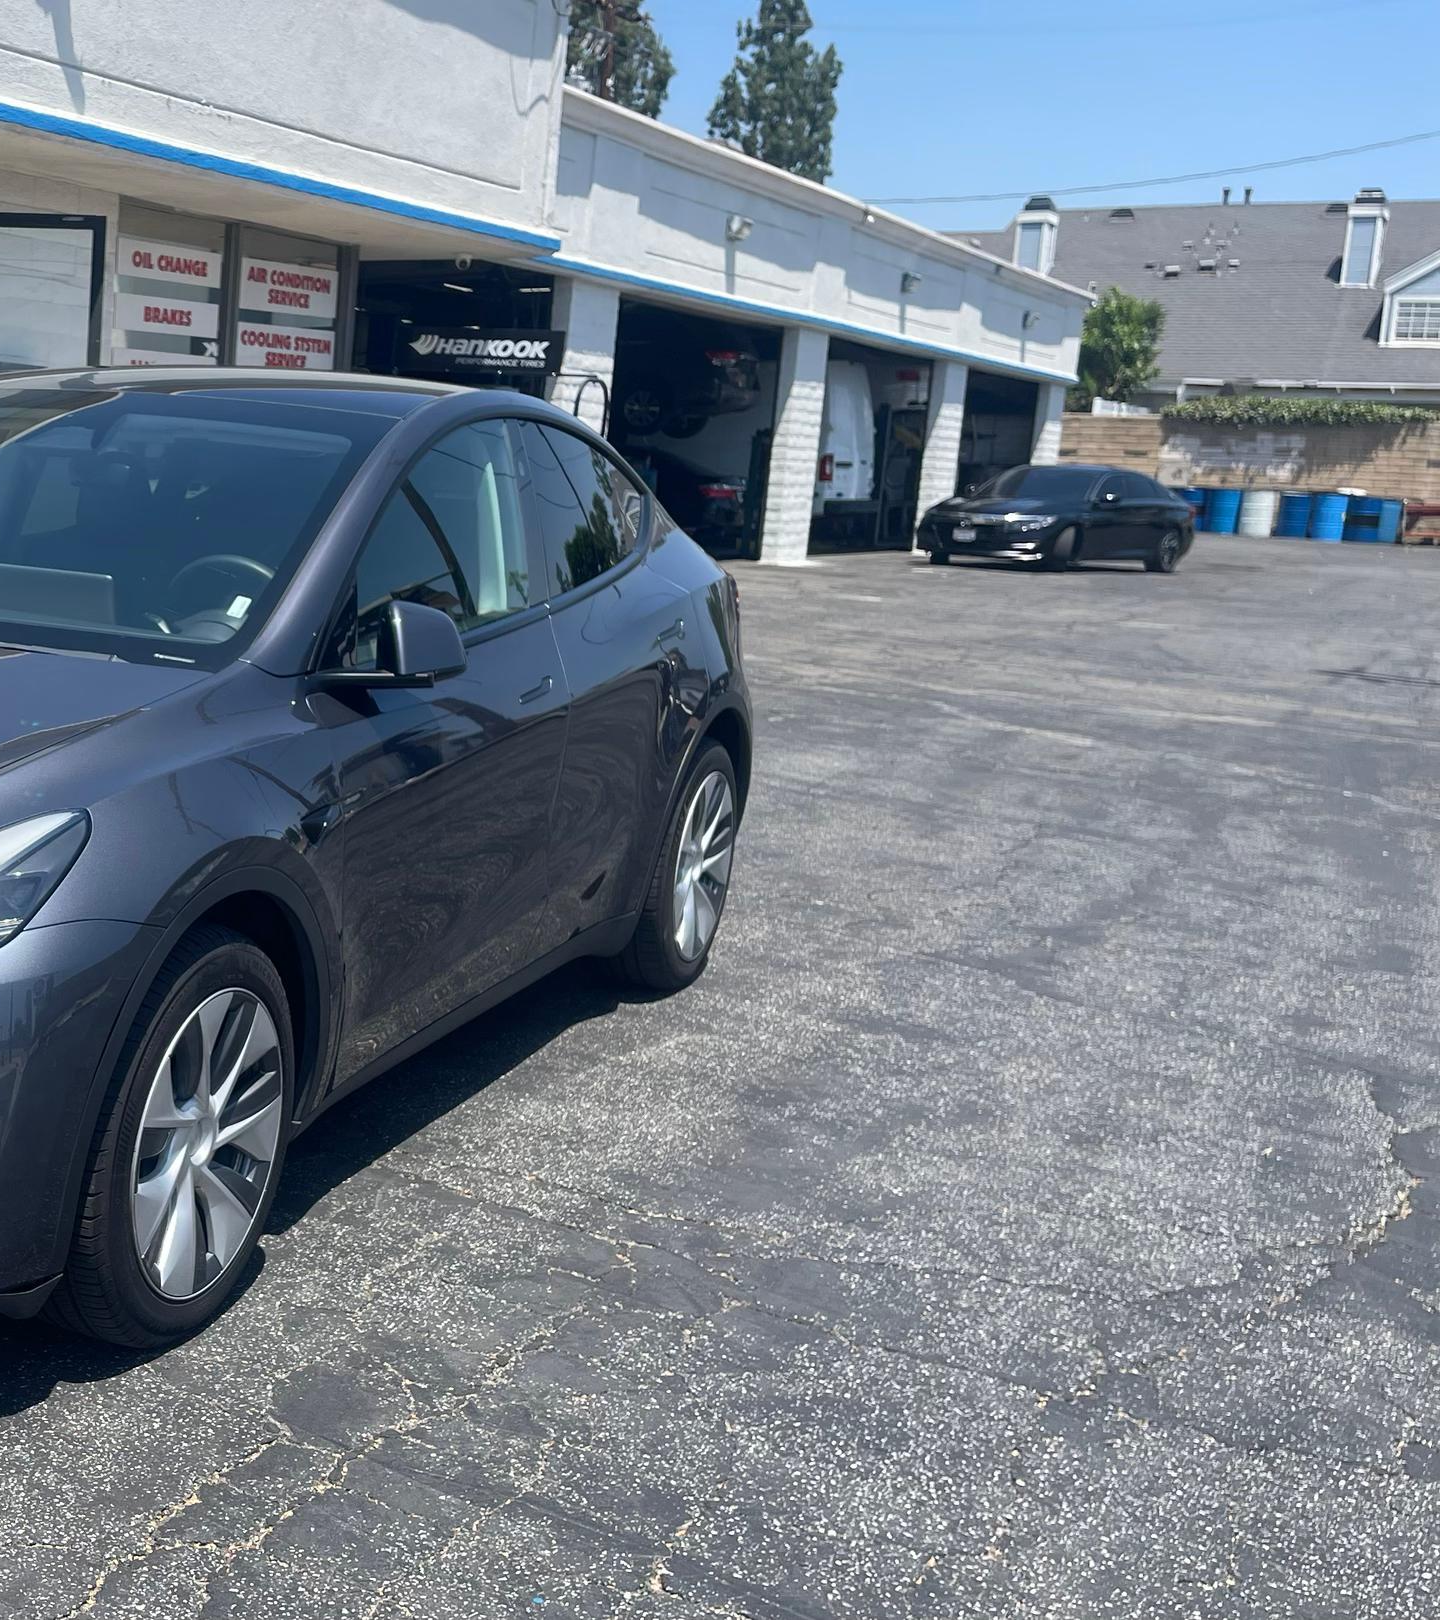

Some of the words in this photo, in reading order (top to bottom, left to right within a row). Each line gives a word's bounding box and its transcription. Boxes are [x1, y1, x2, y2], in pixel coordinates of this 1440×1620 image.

[132, 250, 153, 269] OIL
[157, 255, 208, 277] CHANGE
[248, 266, 267, 283] AIR
[270, 270, 331, 294] CONDITION
[267, 289, 310, 309] SERVICE
[143, 306, 192, 327] BRAKES
[240, 330, 291, 350] COOLING
[294, 336, 331, 355] SYSTEM
[265, 352, 306, 368] SERVICE
[520, 359, 545, 368] TIRES
